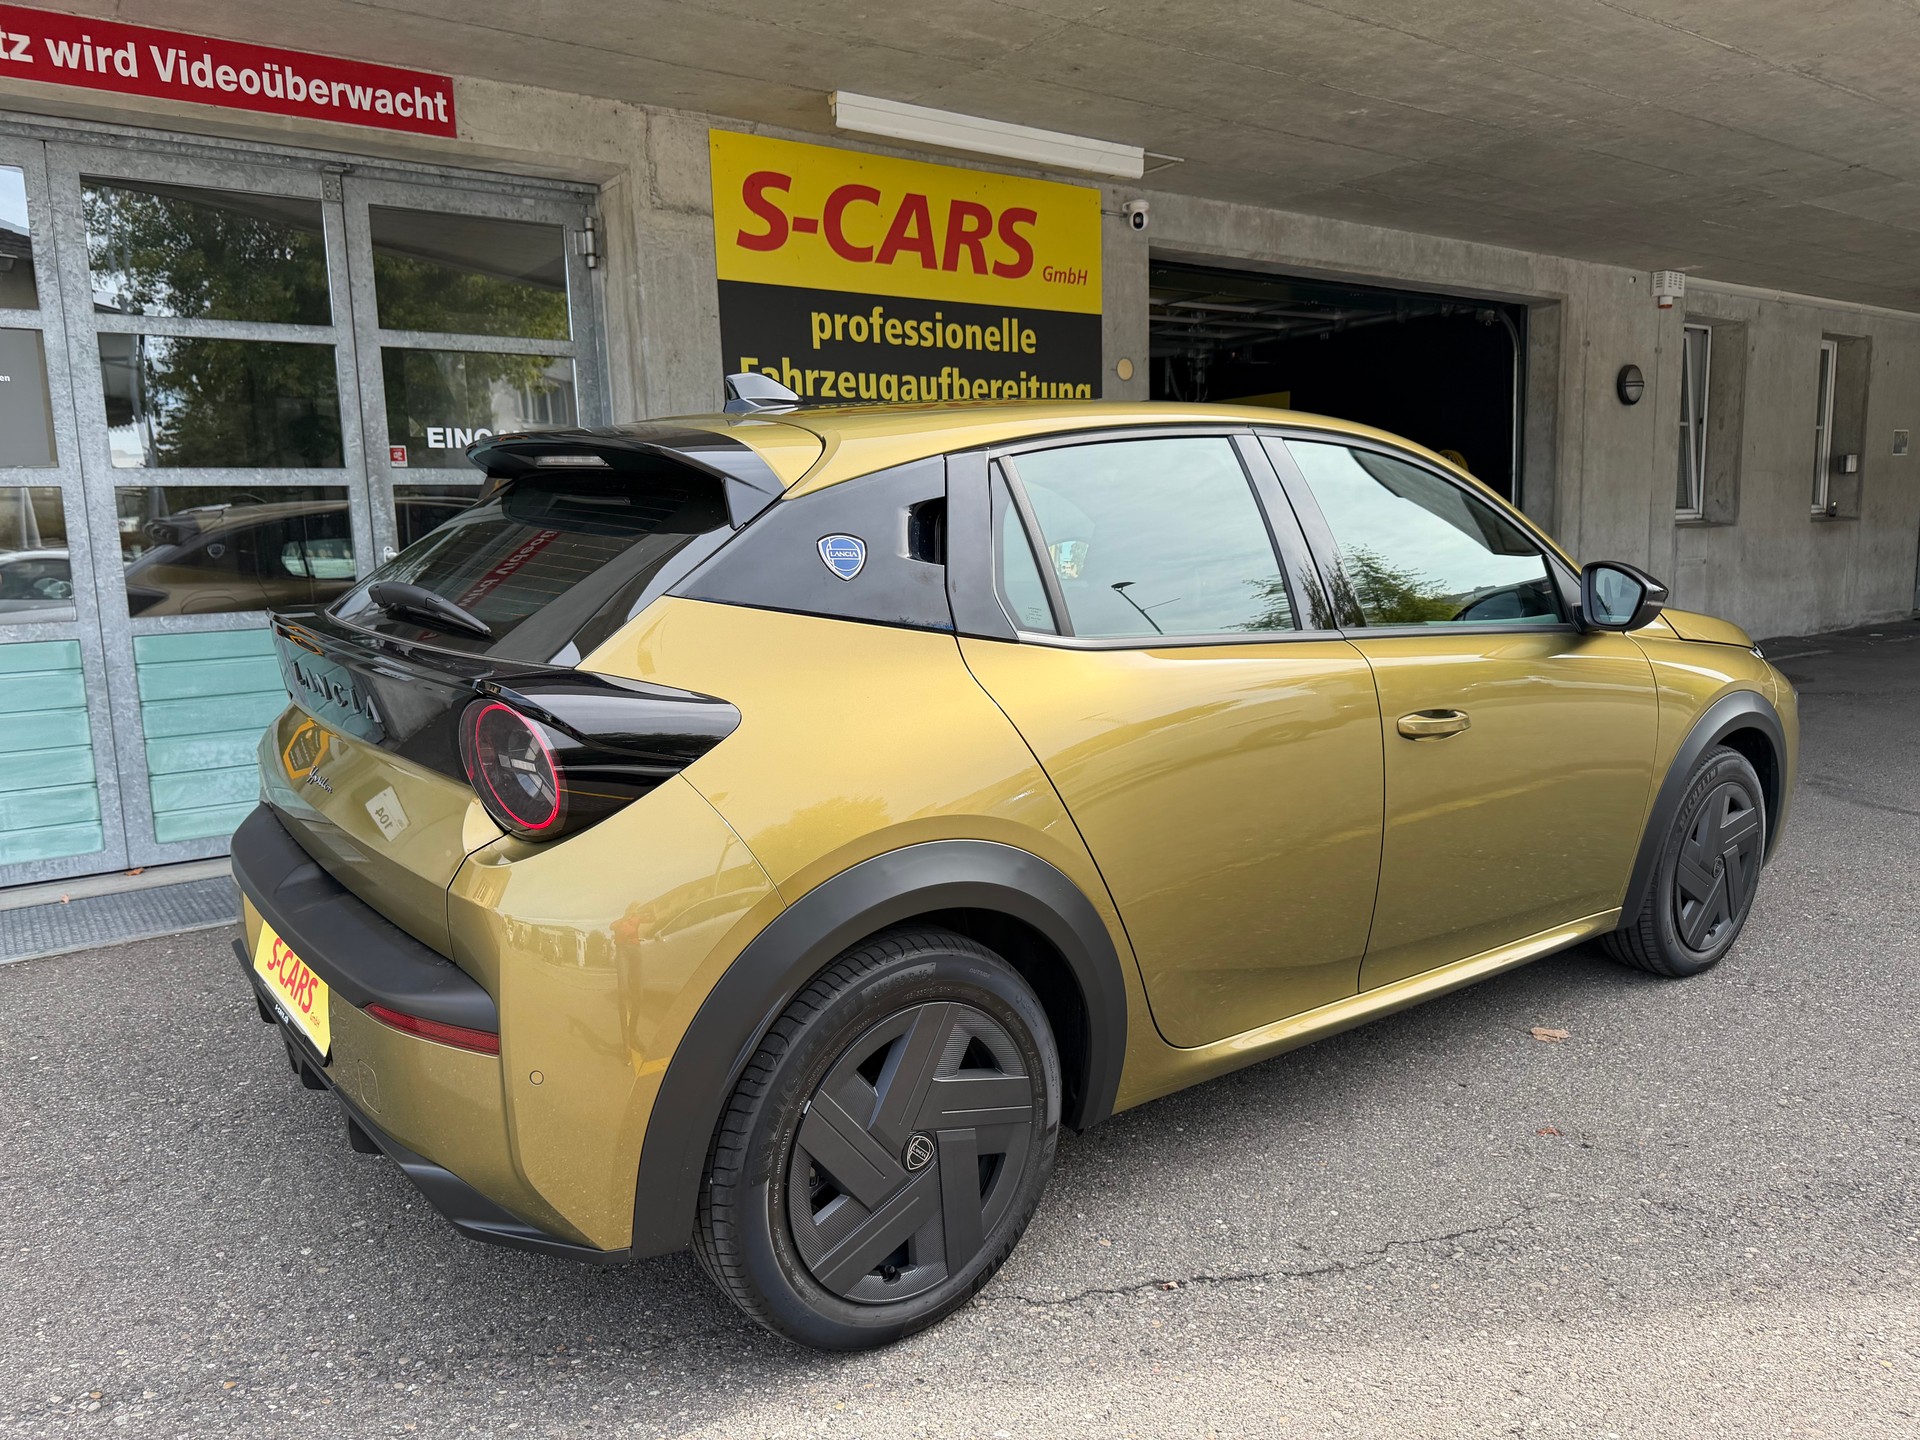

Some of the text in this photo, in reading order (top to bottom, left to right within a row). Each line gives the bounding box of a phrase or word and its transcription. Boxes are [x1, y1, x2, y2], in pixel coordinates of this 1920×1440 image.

[44, 34, 139, 79] wird
[149, 44, 449, 123] Videoüberwacht
[736, 170, 1088, 286] S-CARS GmbH
[811, 306, 1037, 354] professionelle
[294, 660, 382, 723] LANCIA
[267, 936, 319, 1012] S-CARS
